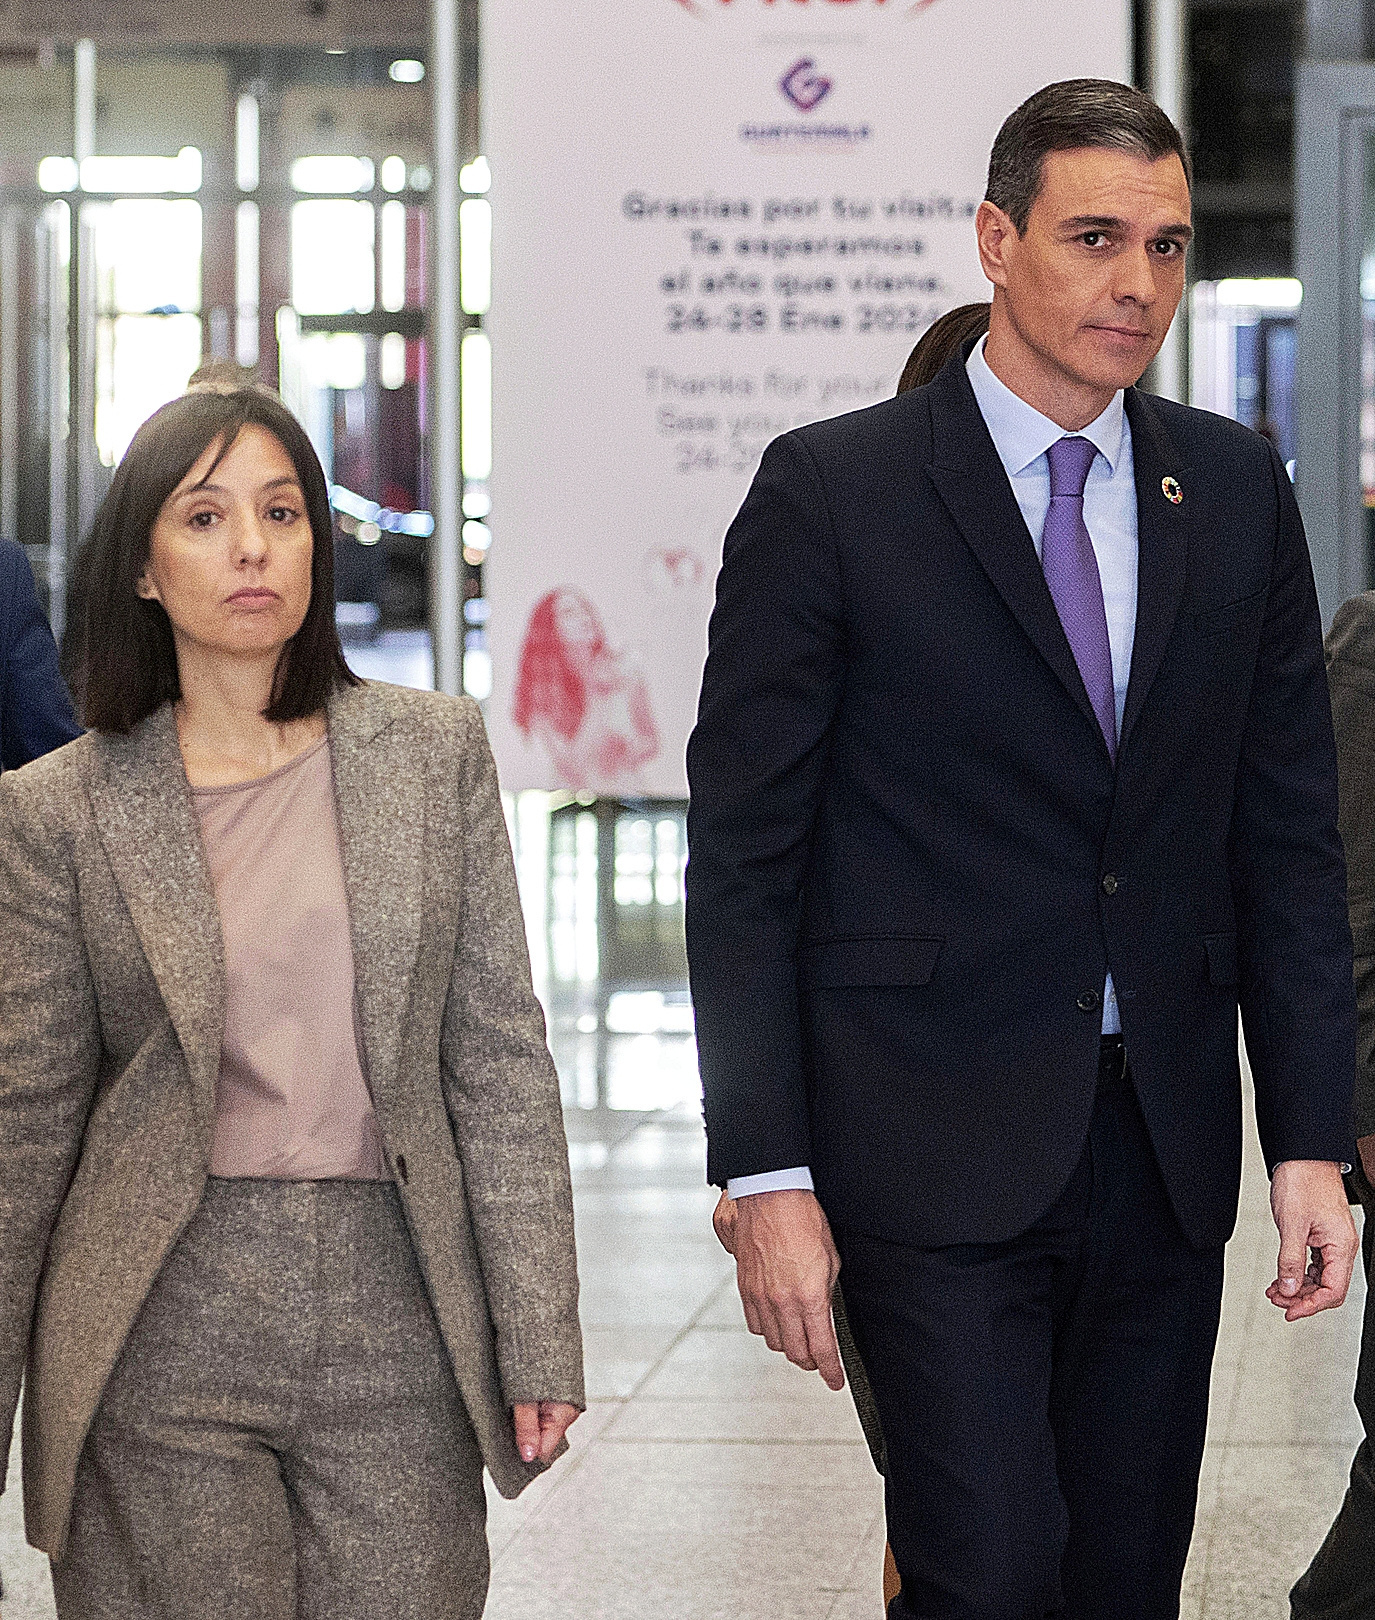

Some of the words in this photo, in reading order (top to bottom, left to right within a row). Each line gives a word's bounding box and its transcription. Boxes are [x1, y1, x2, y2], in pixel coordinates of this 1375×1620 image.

[621, 190, 752, 220] Gracias
[761, 198, 820, 224] por
[831, 195, 873, 220] tu
[687, 229, 723, 257] Te
[733, 236, 926, 260] esperamos
[659, 268, 690, 293] el
[700, 269, 763, 294] año
[772, 274, 838, 301] que
[666, 303, 769, 333] 24-28
[778, 303, 845, 333] Ene
[643, 366, 755, 396] Thanks
[763, 367, 809, 396] for
[657, 405, 720, 435] See
